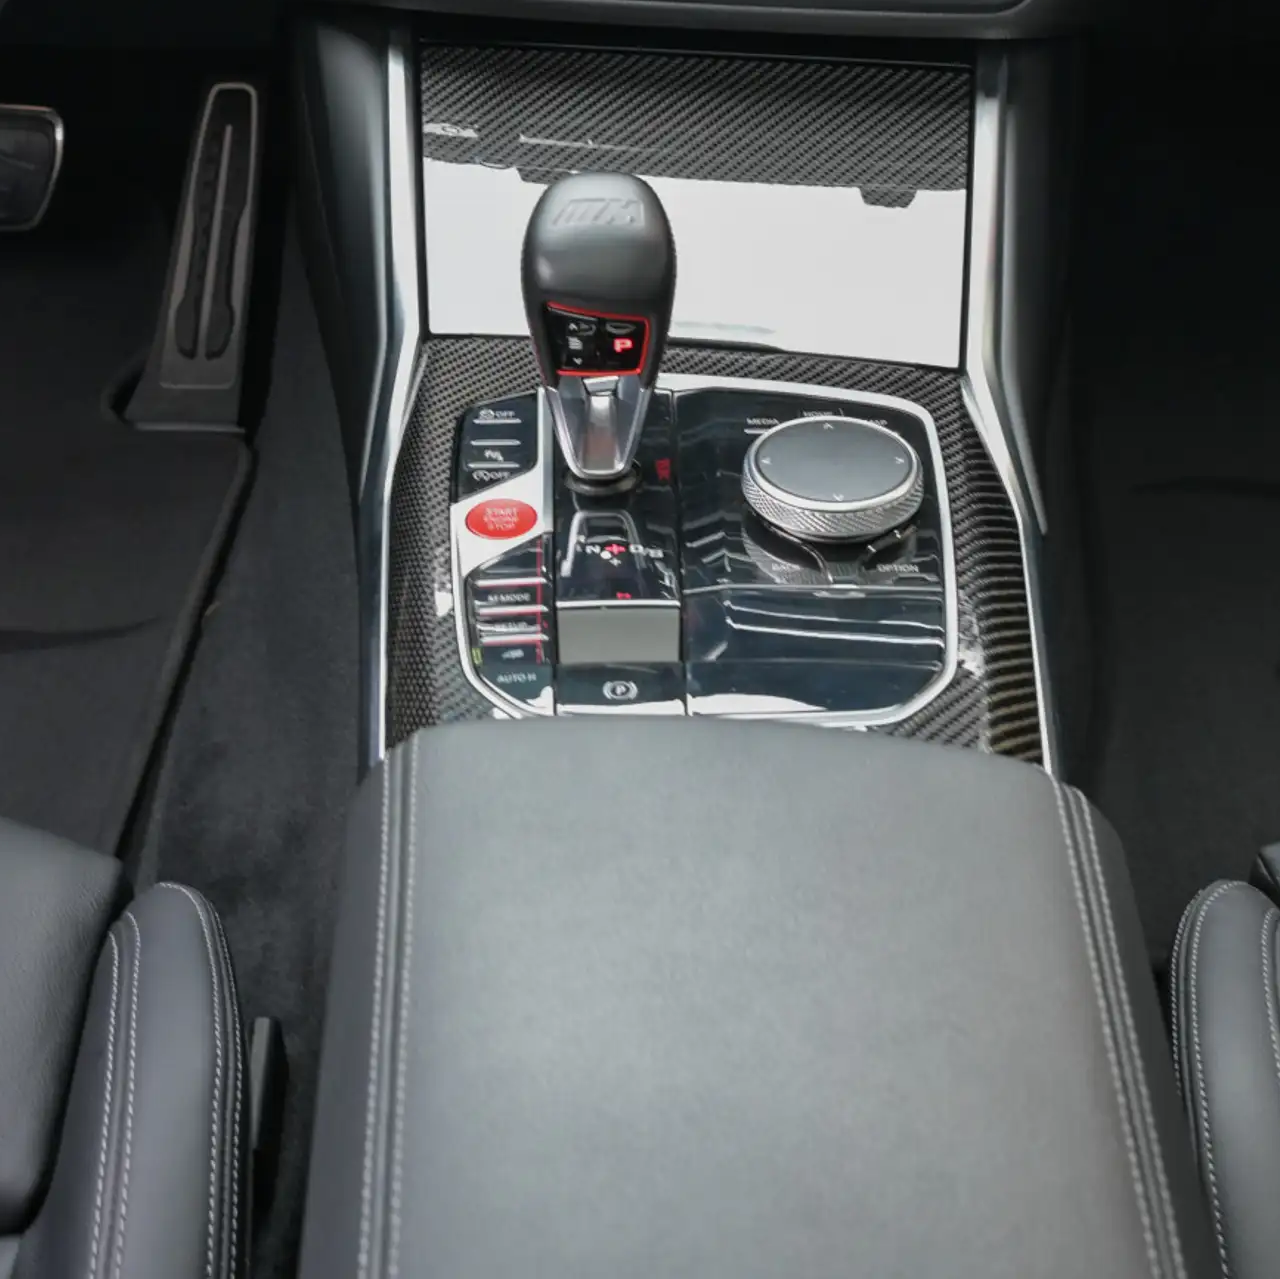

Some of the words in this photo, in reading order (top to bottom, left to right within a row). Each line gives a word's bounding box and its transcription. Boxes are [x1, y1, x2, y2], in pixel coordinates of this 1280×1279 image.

[612, 337, 634, 354] P
[485, 507, 517, 516] START
[487, 522, 515, 531] STOP
[876, 563, 919, 573] OPTION
